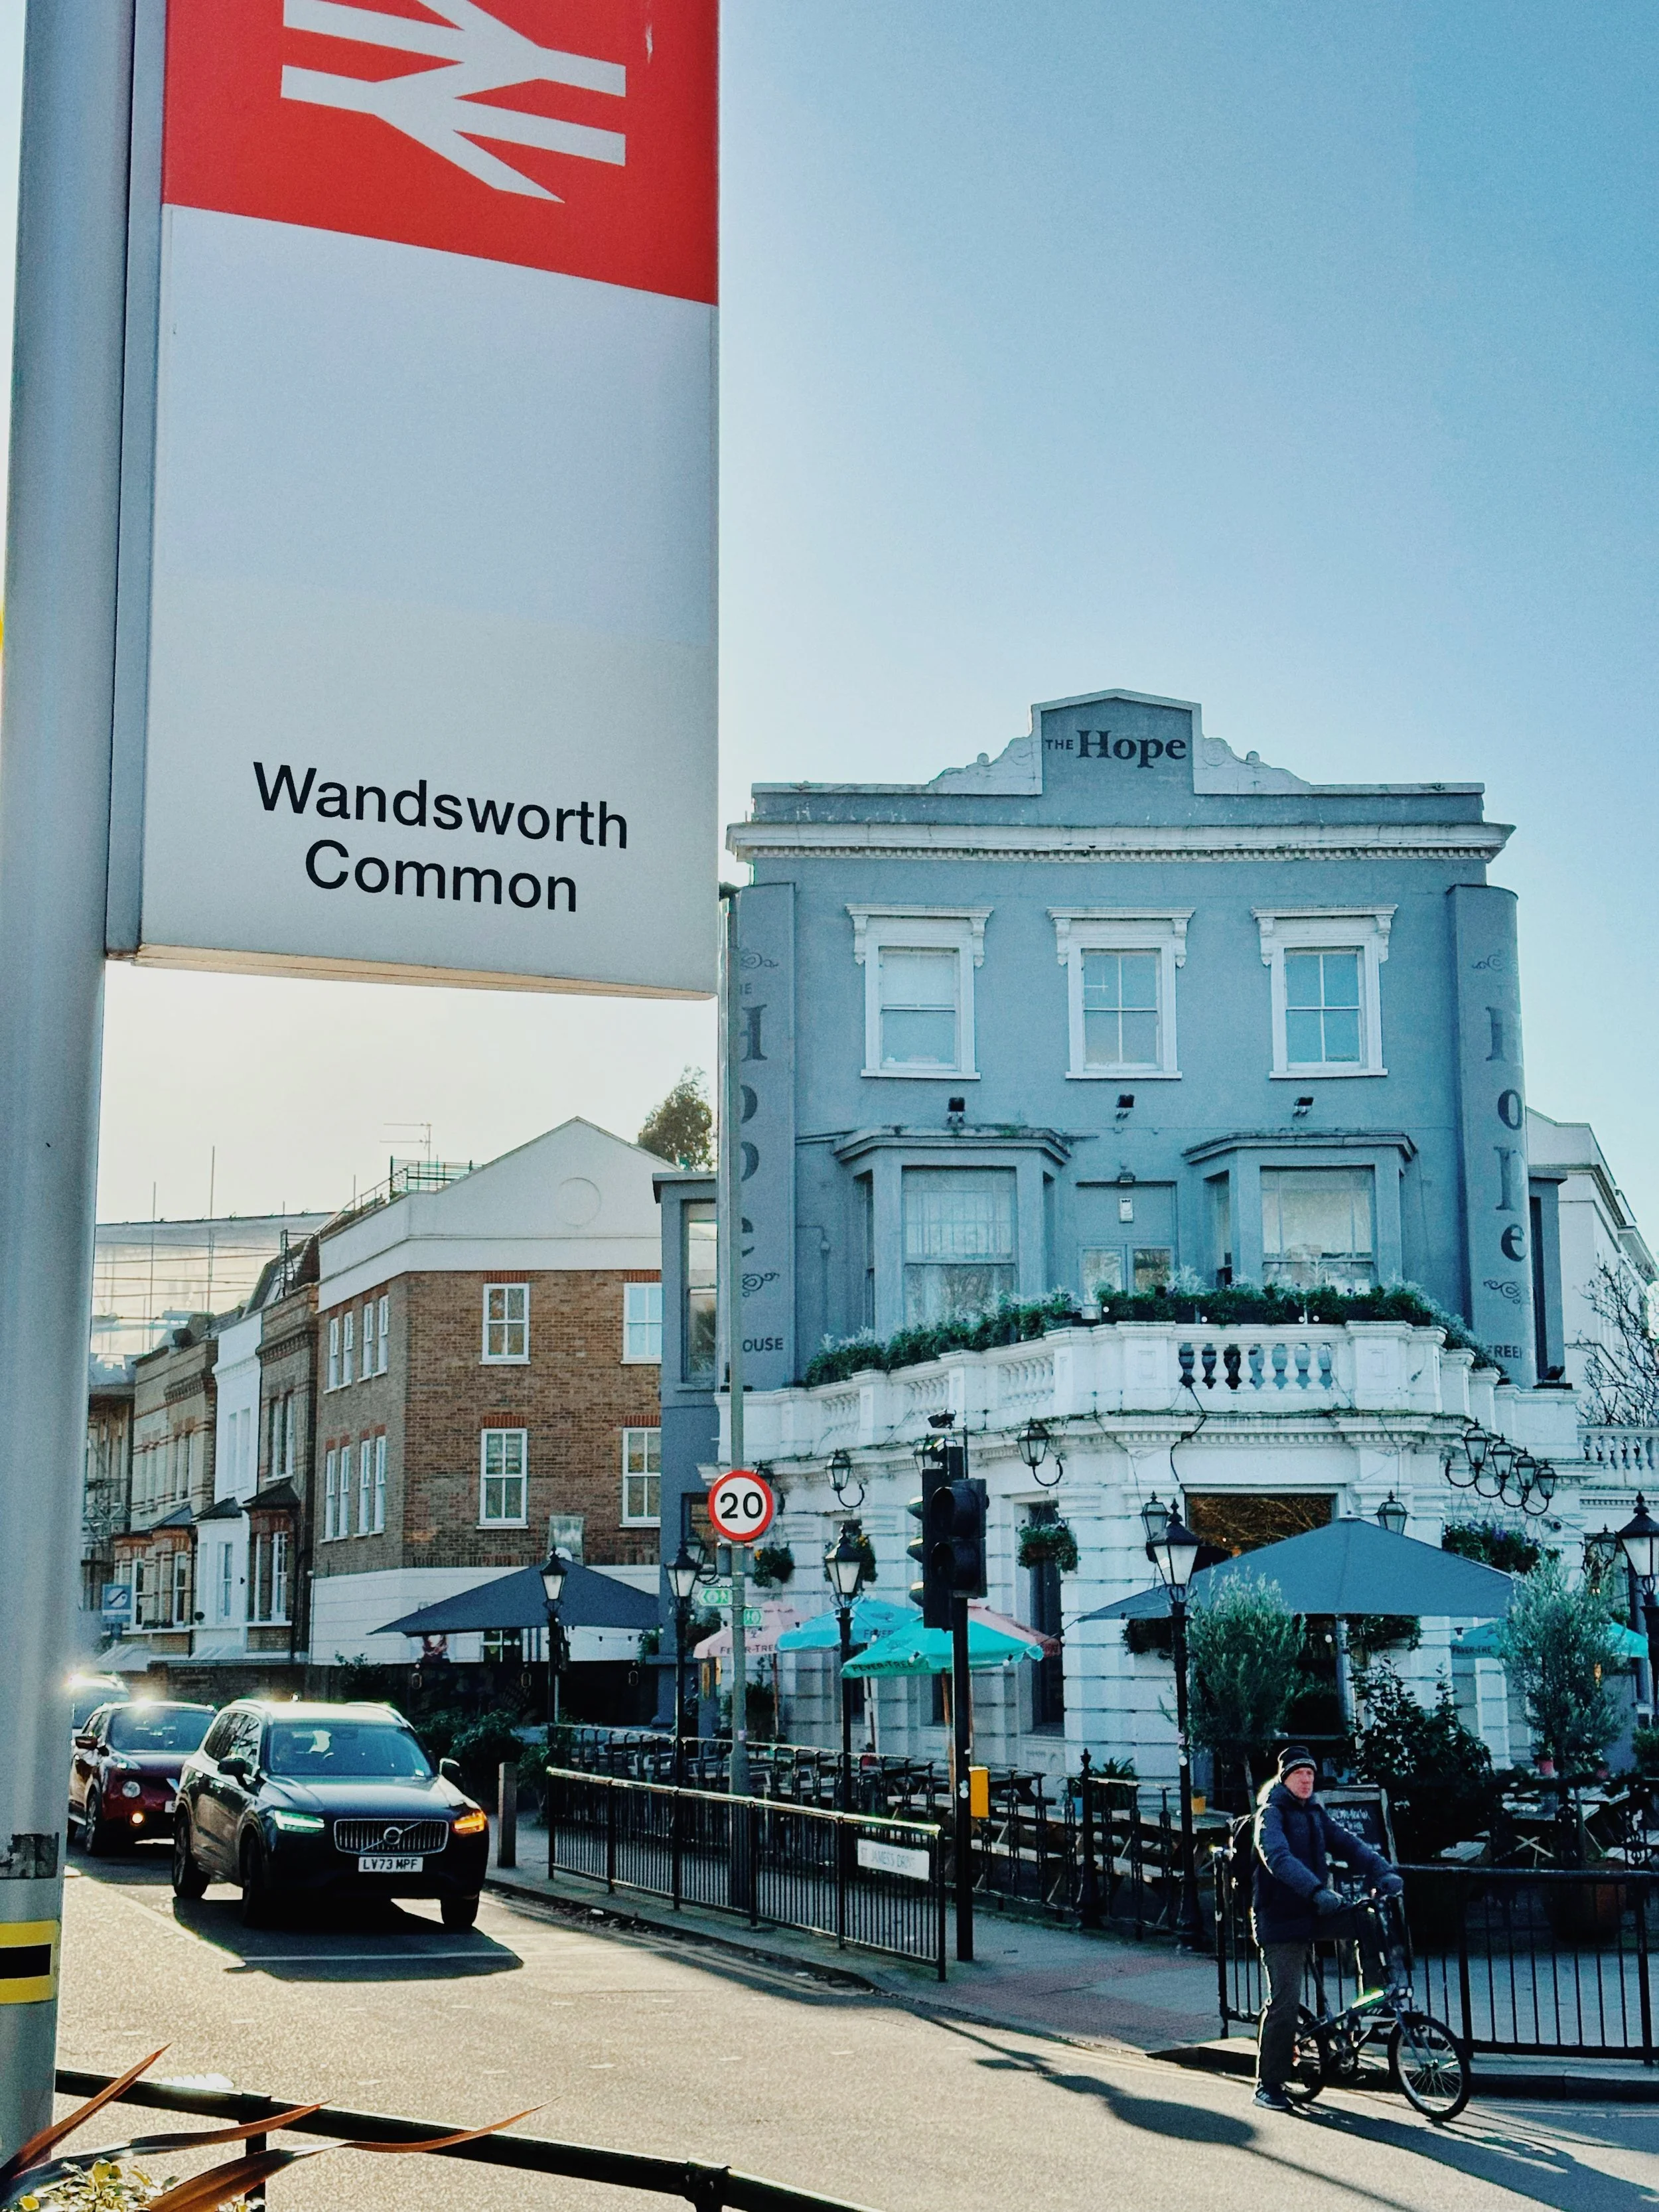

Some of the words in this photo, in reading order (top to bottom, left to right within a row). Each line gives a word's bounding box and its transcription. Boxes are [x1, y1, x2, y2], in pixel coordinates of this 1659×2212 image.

[1045, 739, 1074, 750] THE
[1076, 730, 1187, 769] Hope
[253, 761, 627, 849] Wandsworth
[305, 839, 576, 913] Common
[720, 1491, 763, 1519] 20
[363, 1858, 393, 1870] LV73
[396, 1858, 417, 1870] MPF
